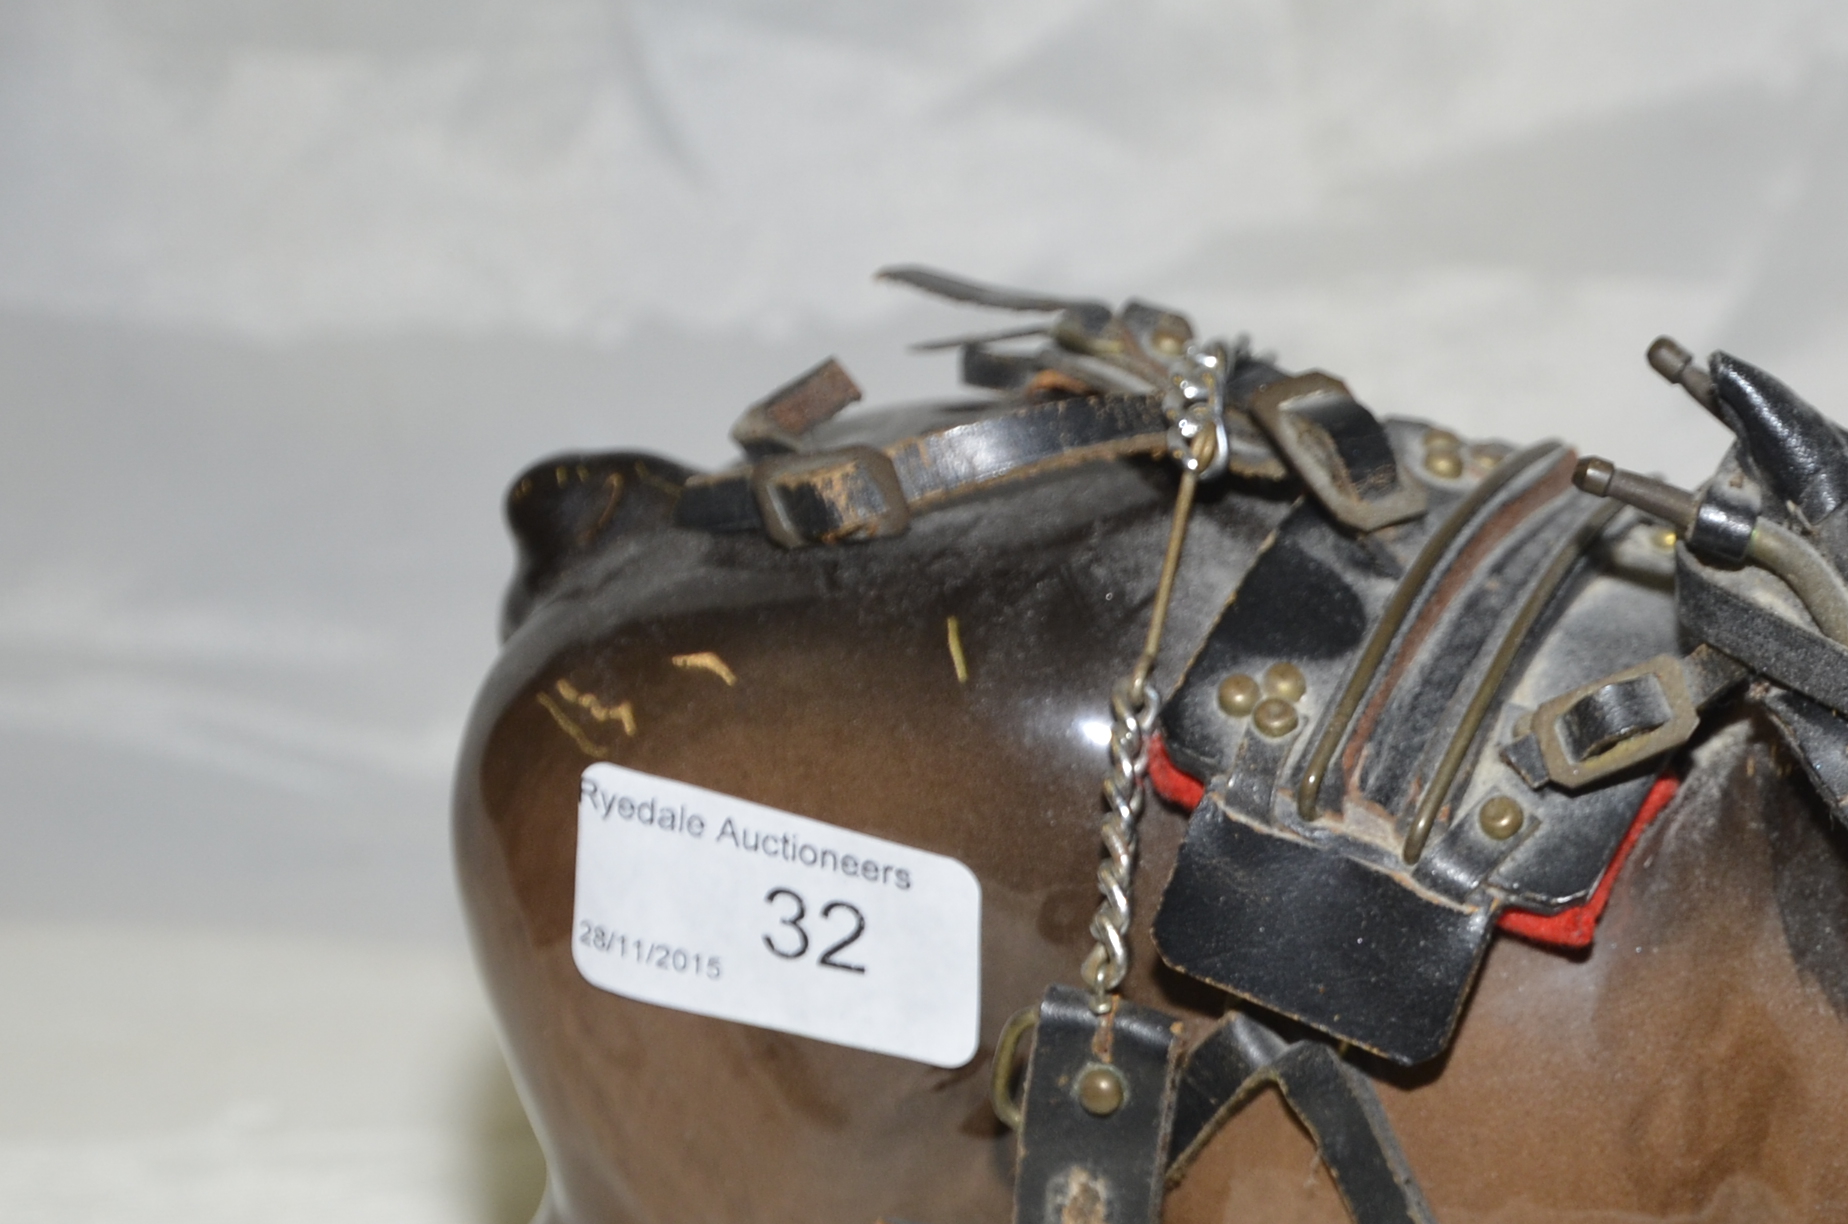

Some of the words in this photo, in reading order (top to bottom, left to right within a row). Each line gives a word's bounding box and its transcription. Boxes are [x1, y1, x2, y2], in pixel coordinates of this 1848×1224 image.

[579, 777, 705, 838] Ryedale
[717, 817, 912, 891] Auctioneers
[579, 920, 722, 980] 28/11/2015
[762, 886, 868, 975] 32
